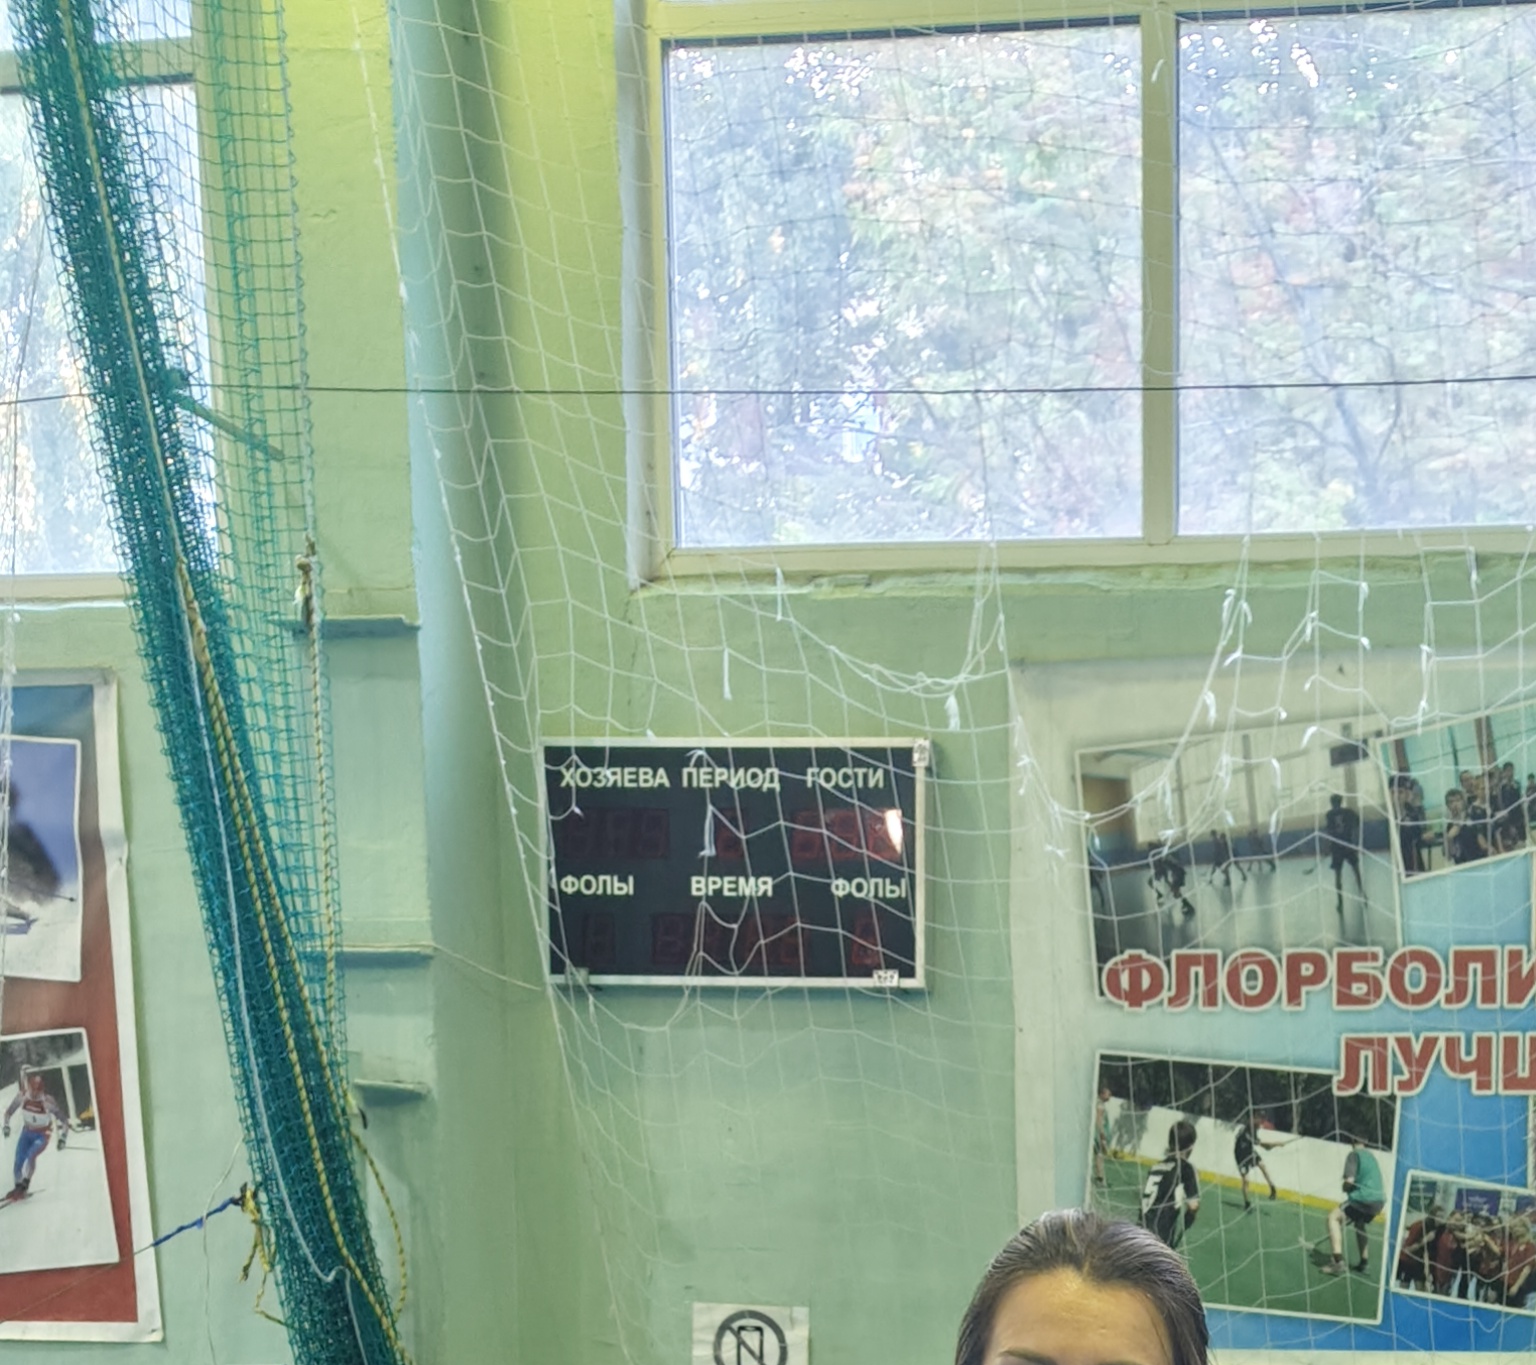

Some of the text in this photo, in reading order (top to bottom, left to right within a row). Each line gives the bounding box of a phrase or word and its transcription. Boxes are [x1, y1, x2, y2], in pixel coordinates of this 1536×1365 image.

[559, 767, 884, 792] ХОЗЯЕВА ПЕРИОД ГОСТИ
[560, 874, 906, 899] ФОЛЫ ВРЕМЯ ФОЛЫ
